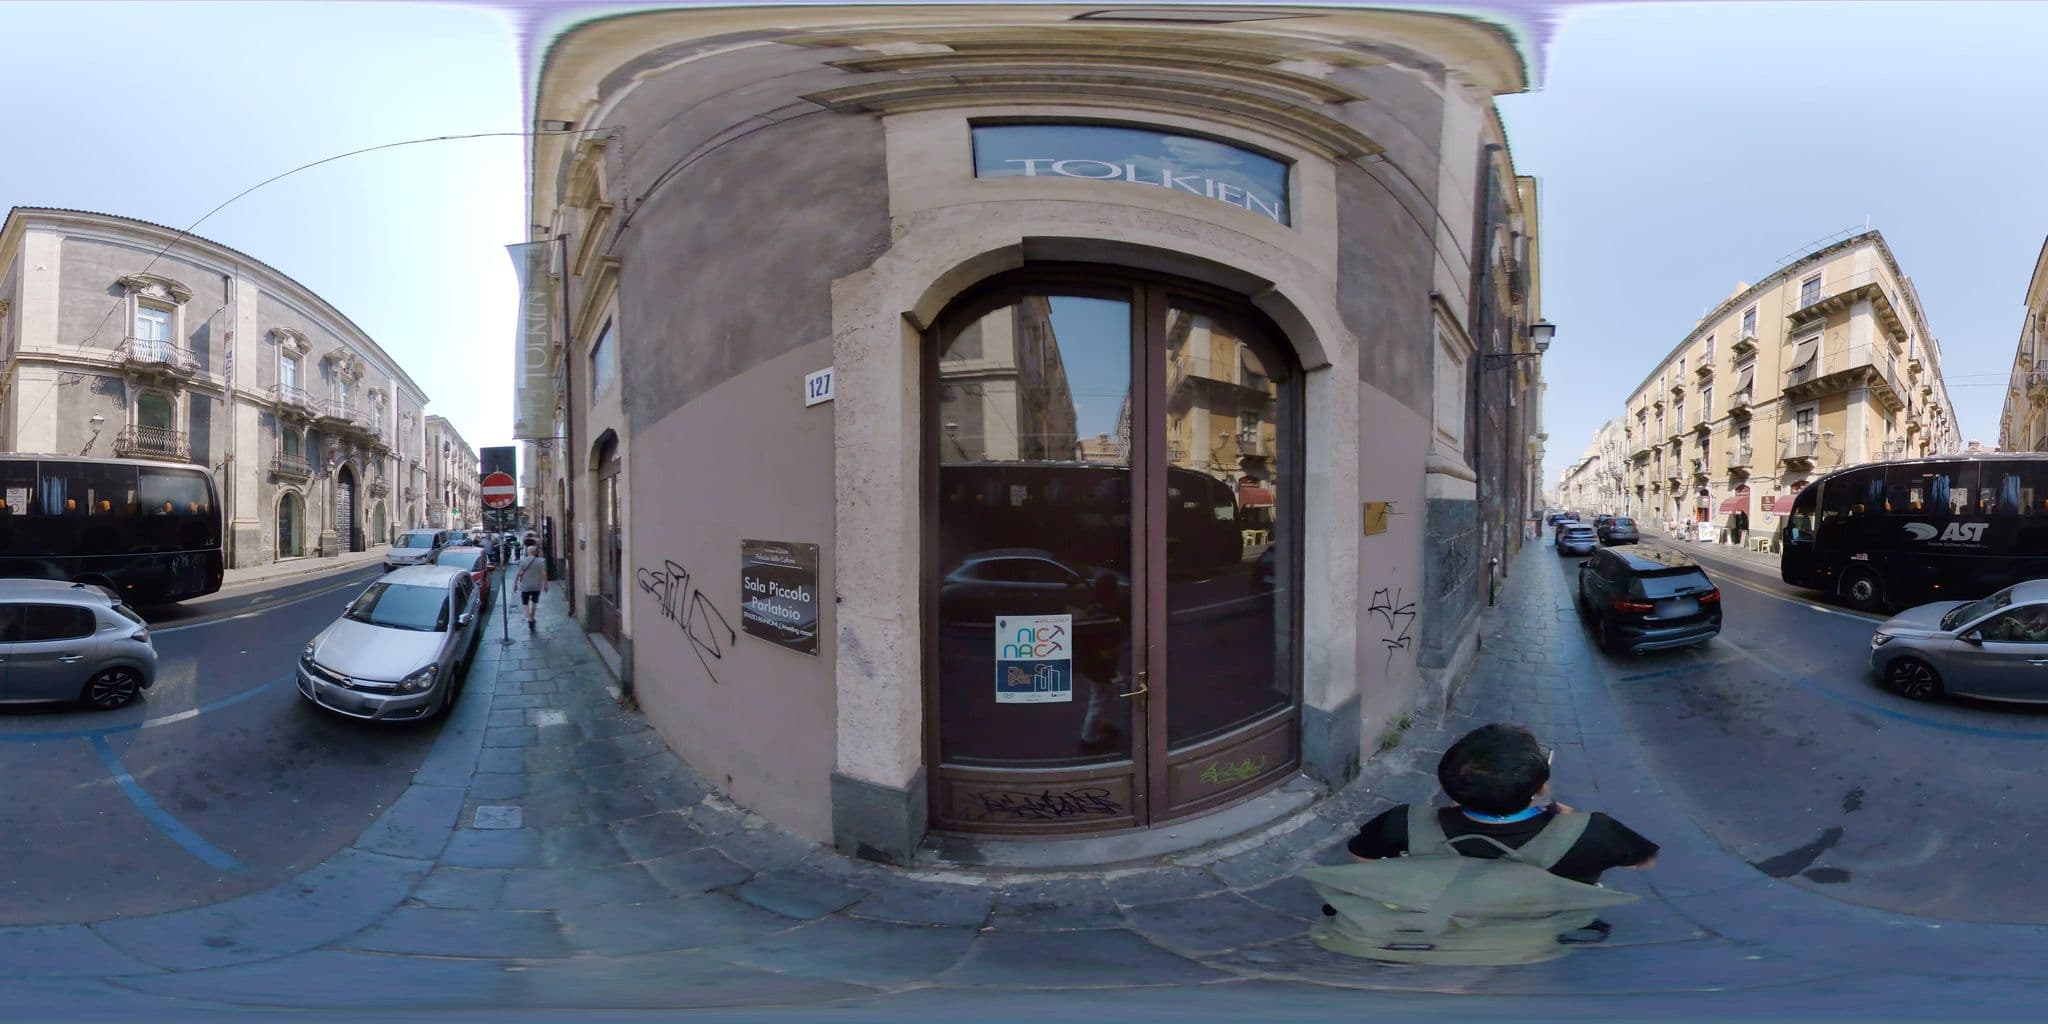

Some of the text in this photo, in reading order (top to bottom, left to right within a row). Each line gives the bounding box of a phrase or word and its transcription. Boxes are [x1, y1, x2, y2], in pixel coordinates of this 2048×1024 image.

[1004, 158, 1280, 224] TOLKIEN
[809, 373, 830, 398] 127
[1940, 522, 1990, 542] AST
[744, 577, 810, 602] Sala Piccolo
[752, 596, 801, 620] Parlatoio
